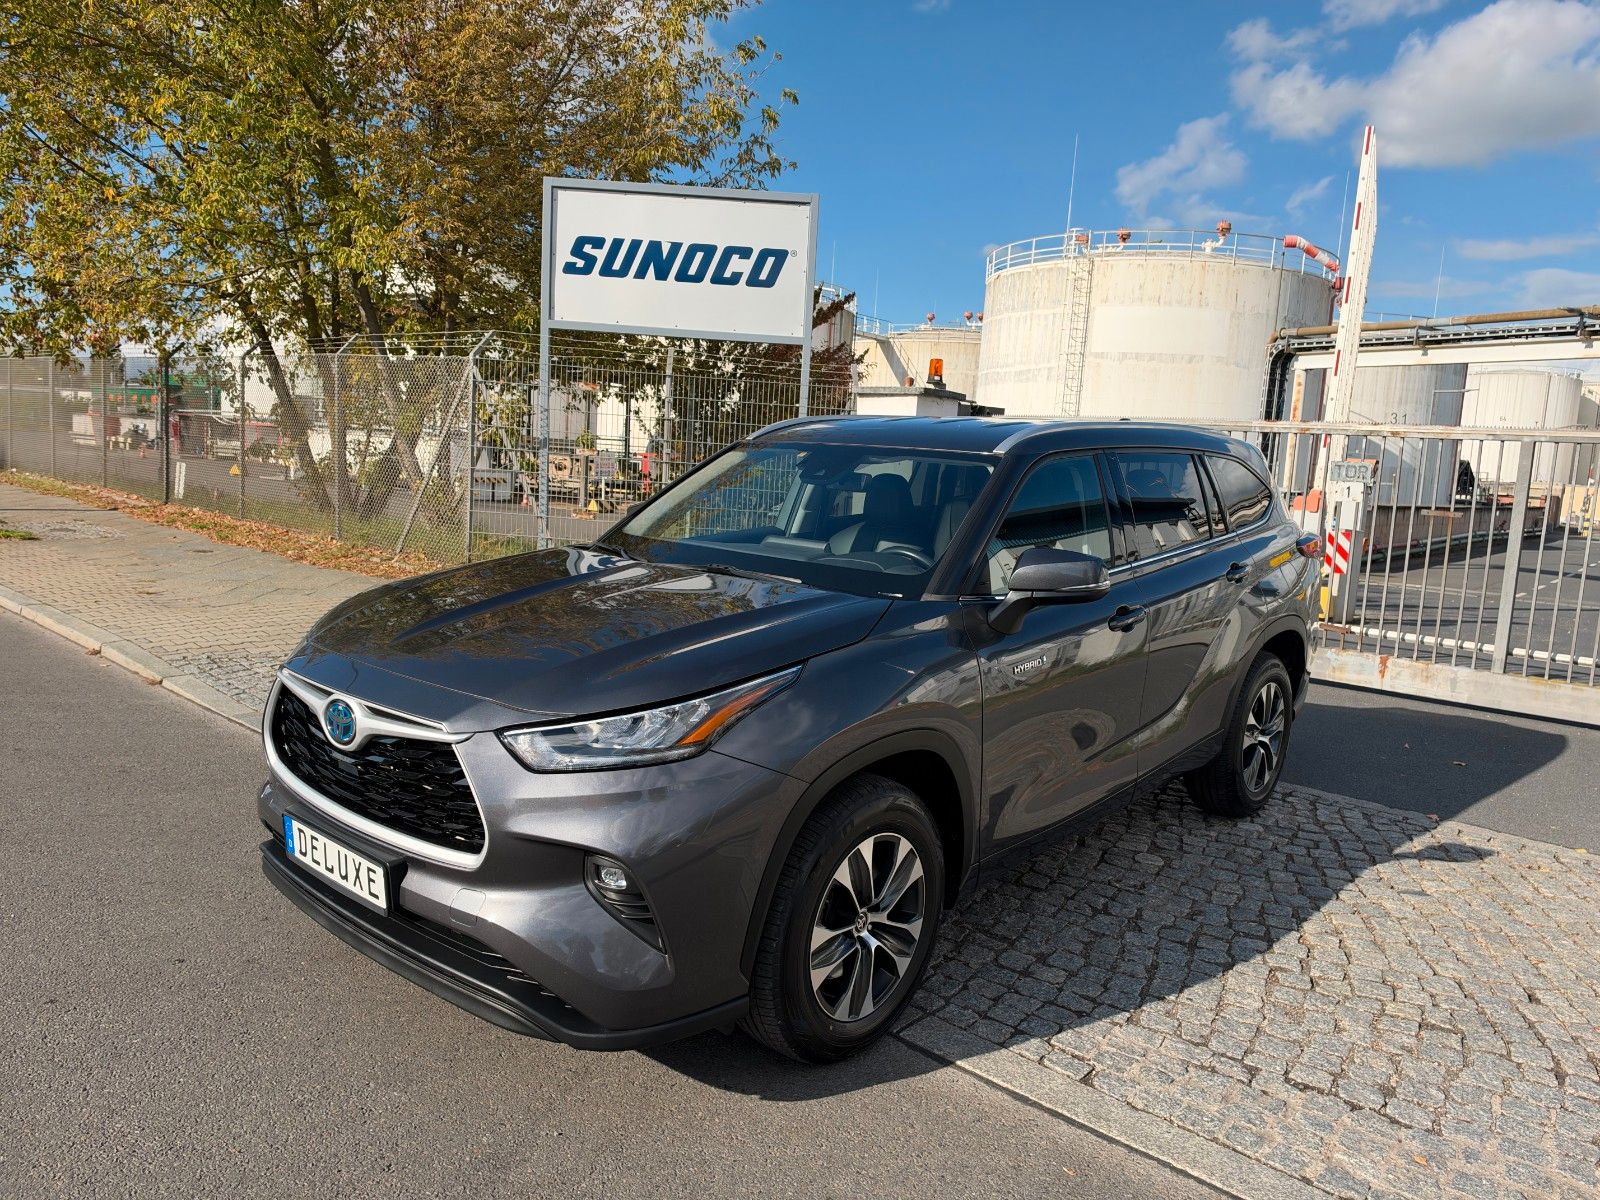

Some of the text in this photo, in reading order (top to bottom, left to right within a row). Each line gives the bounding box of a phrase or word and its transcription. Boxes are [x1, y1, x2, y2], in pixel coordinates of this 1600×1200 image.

[562, 235, 789, 288] SUNOCO
[1334, 464, 1369, 480] TOR
[1013, 658, 1042, 674] HYBRID
[297, 827, 380, 900] DELUXE
